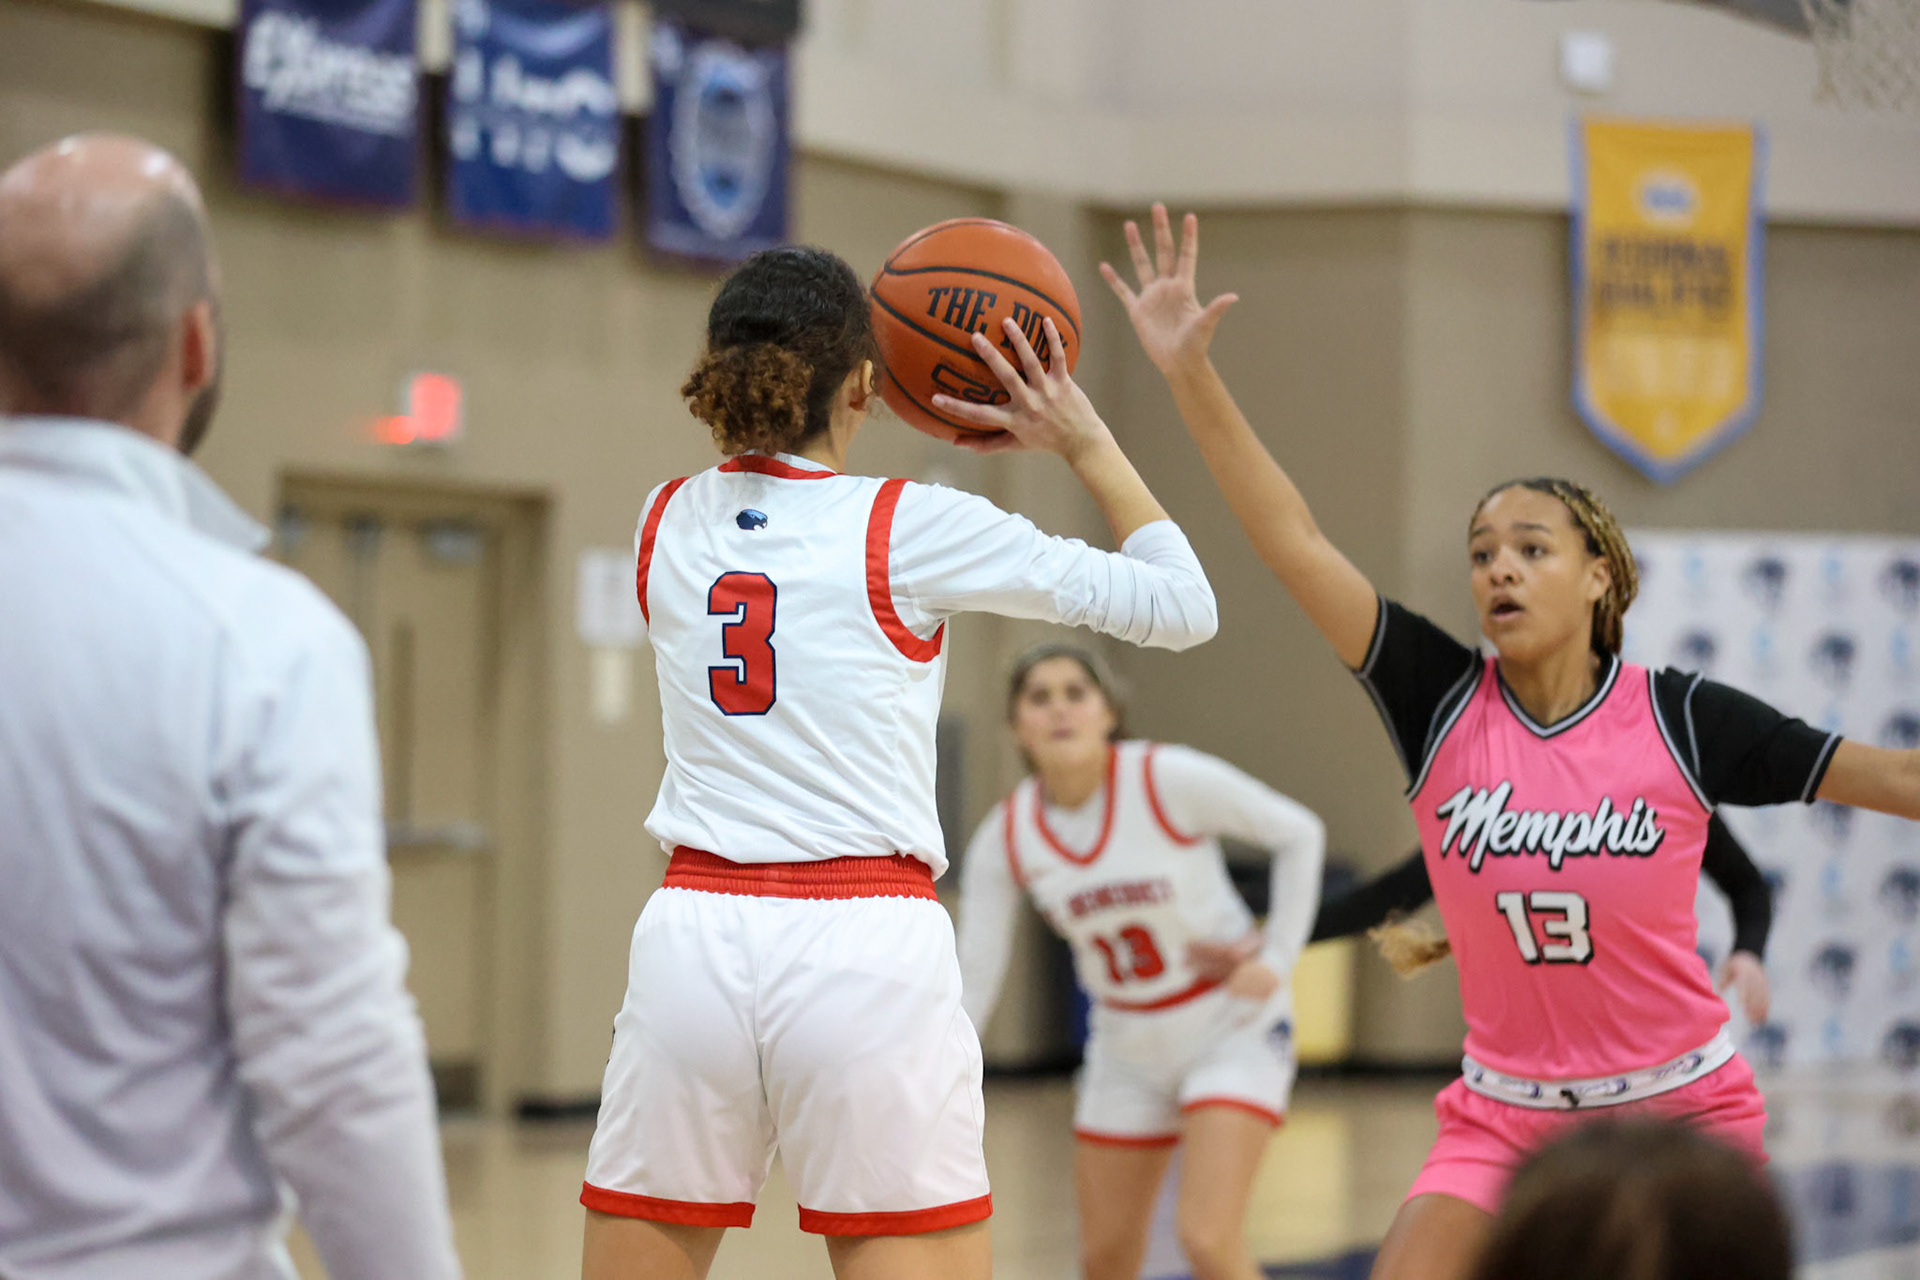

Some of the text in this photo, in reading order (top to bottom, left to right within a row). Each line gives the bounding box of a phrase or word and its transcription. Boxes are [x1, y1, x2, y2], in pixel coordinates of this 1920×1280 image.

[926, 286, 998, 335] THE
[707, 570, 777, 716] 3
[1436, 779, 1666, 874] Memphis
[1091, 923, 1166, 984] 13
[1495, 889, 1595, 965] 13
